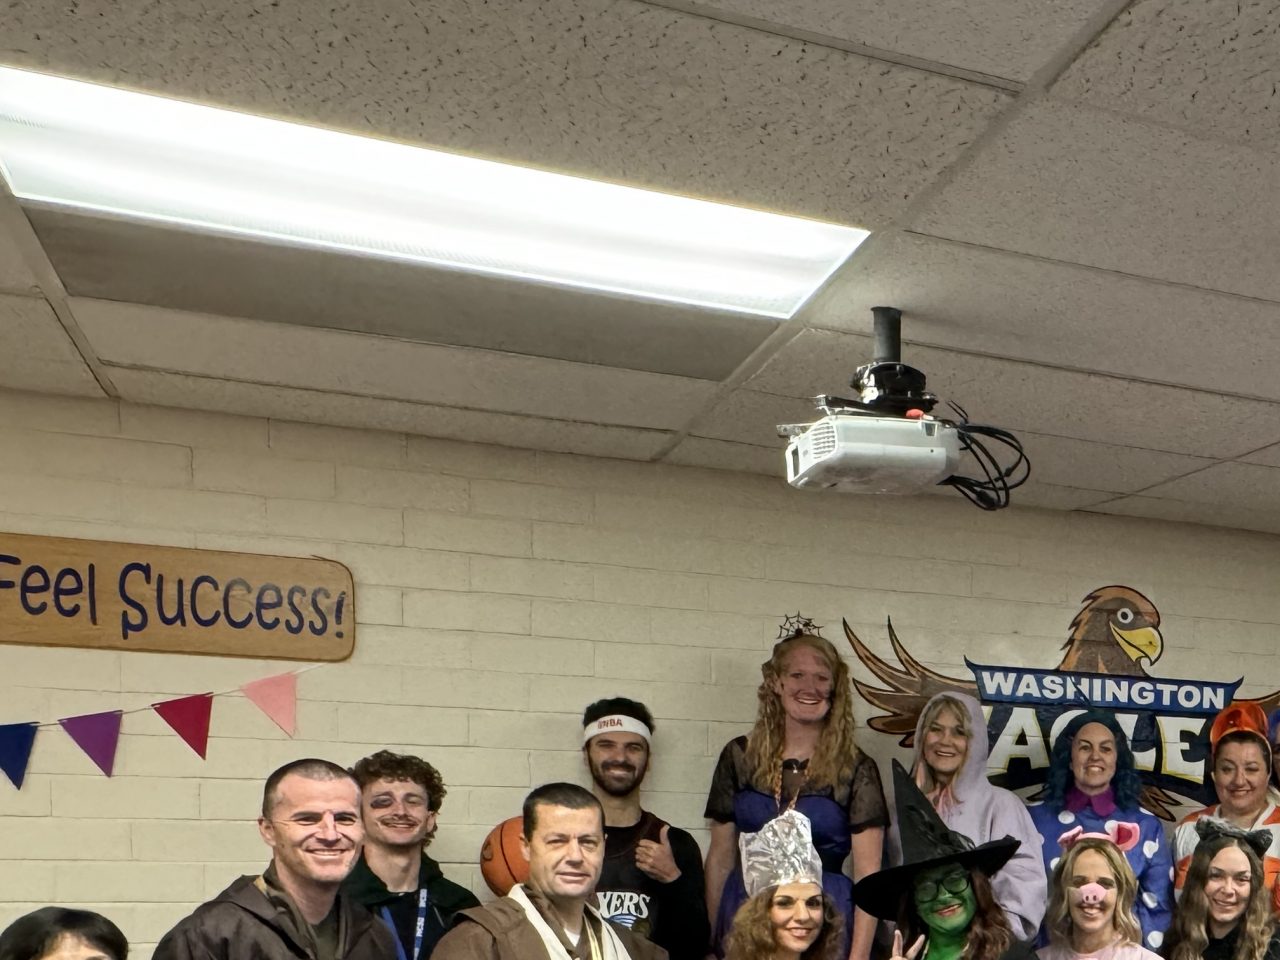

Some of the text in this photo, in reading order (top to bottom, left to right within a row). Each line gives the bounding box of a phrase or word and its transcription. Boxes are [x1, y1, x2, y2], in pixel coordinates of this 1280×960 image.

[118, 562, 346, 640] Success!
[982, 671, 1225, 709] WASHINGTON
[602, 718, 623, 728] NBA
